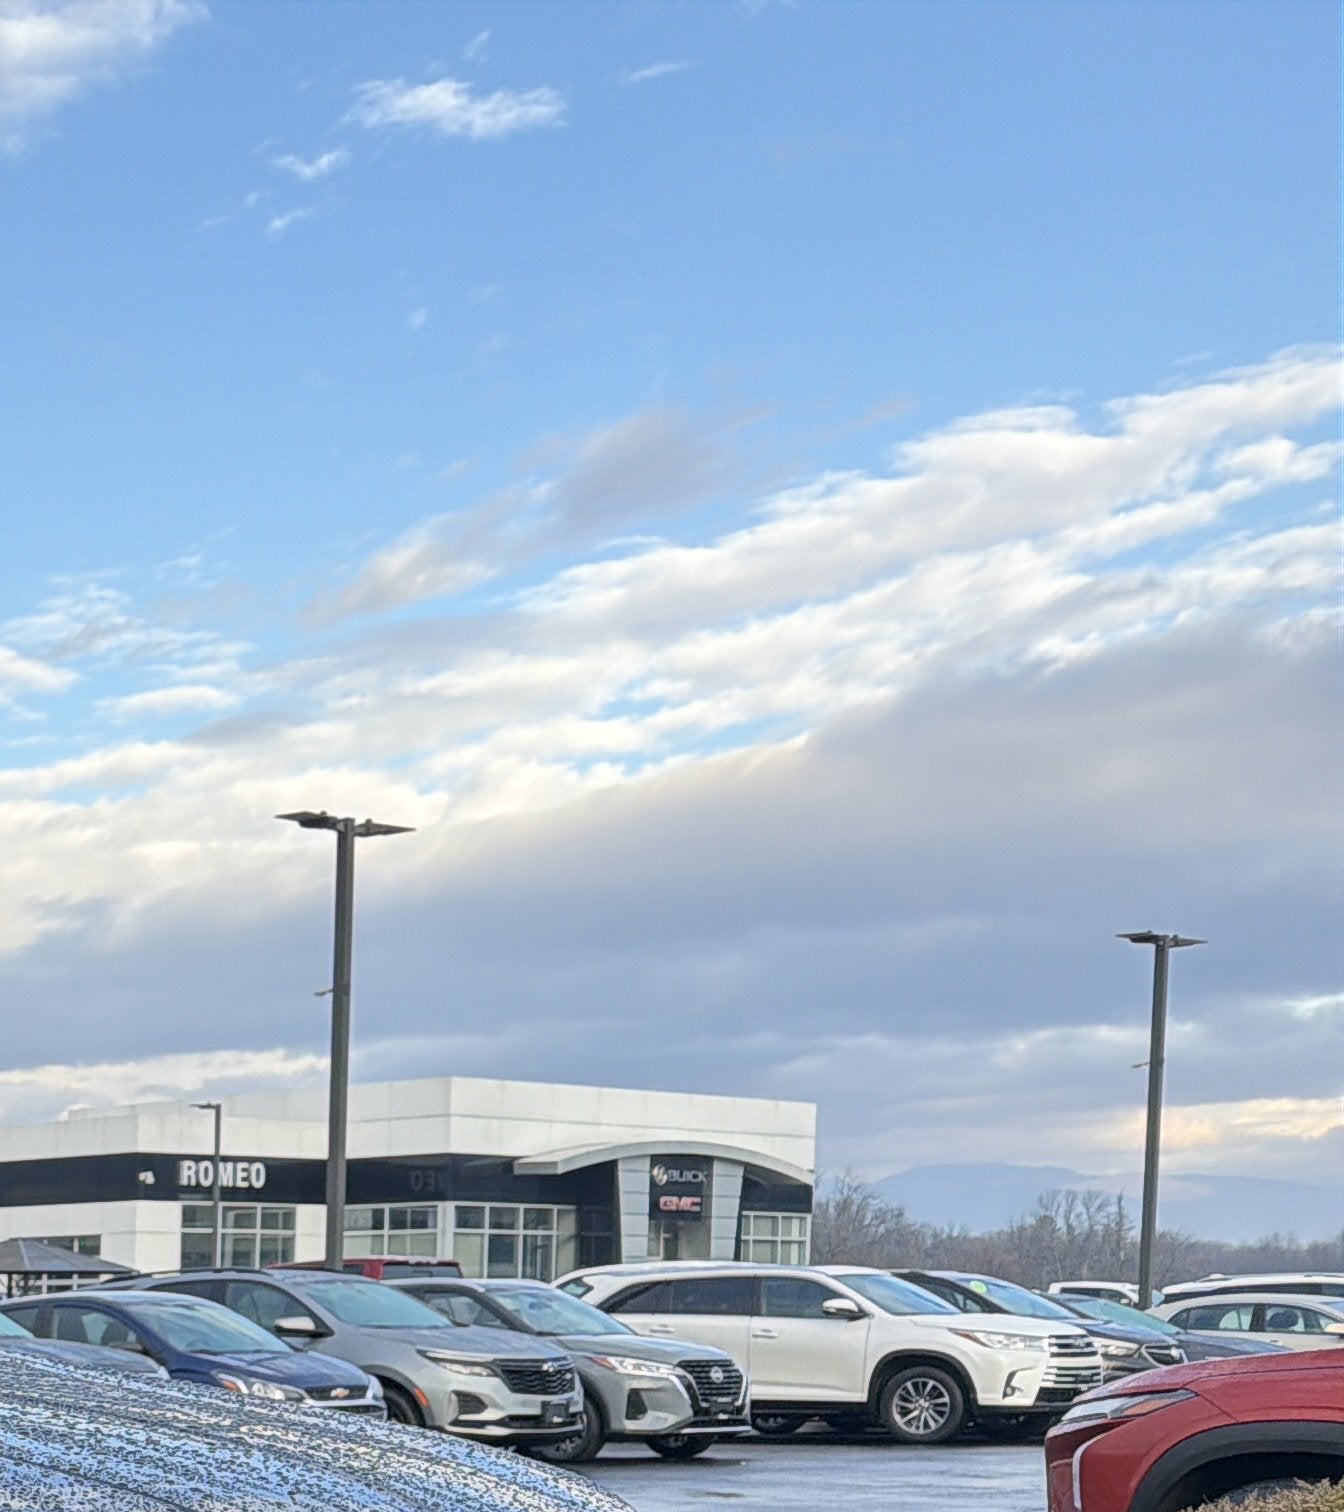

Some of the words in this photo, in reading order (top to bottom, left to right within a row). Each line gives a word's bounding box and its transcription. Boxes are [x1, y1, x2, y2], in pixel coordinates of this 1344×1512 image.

[178, 1160, 267, 1189] ROMEO
[668, 1169, 708, 1183] BUICK
[659, 1195, 702, 1212] GMC
